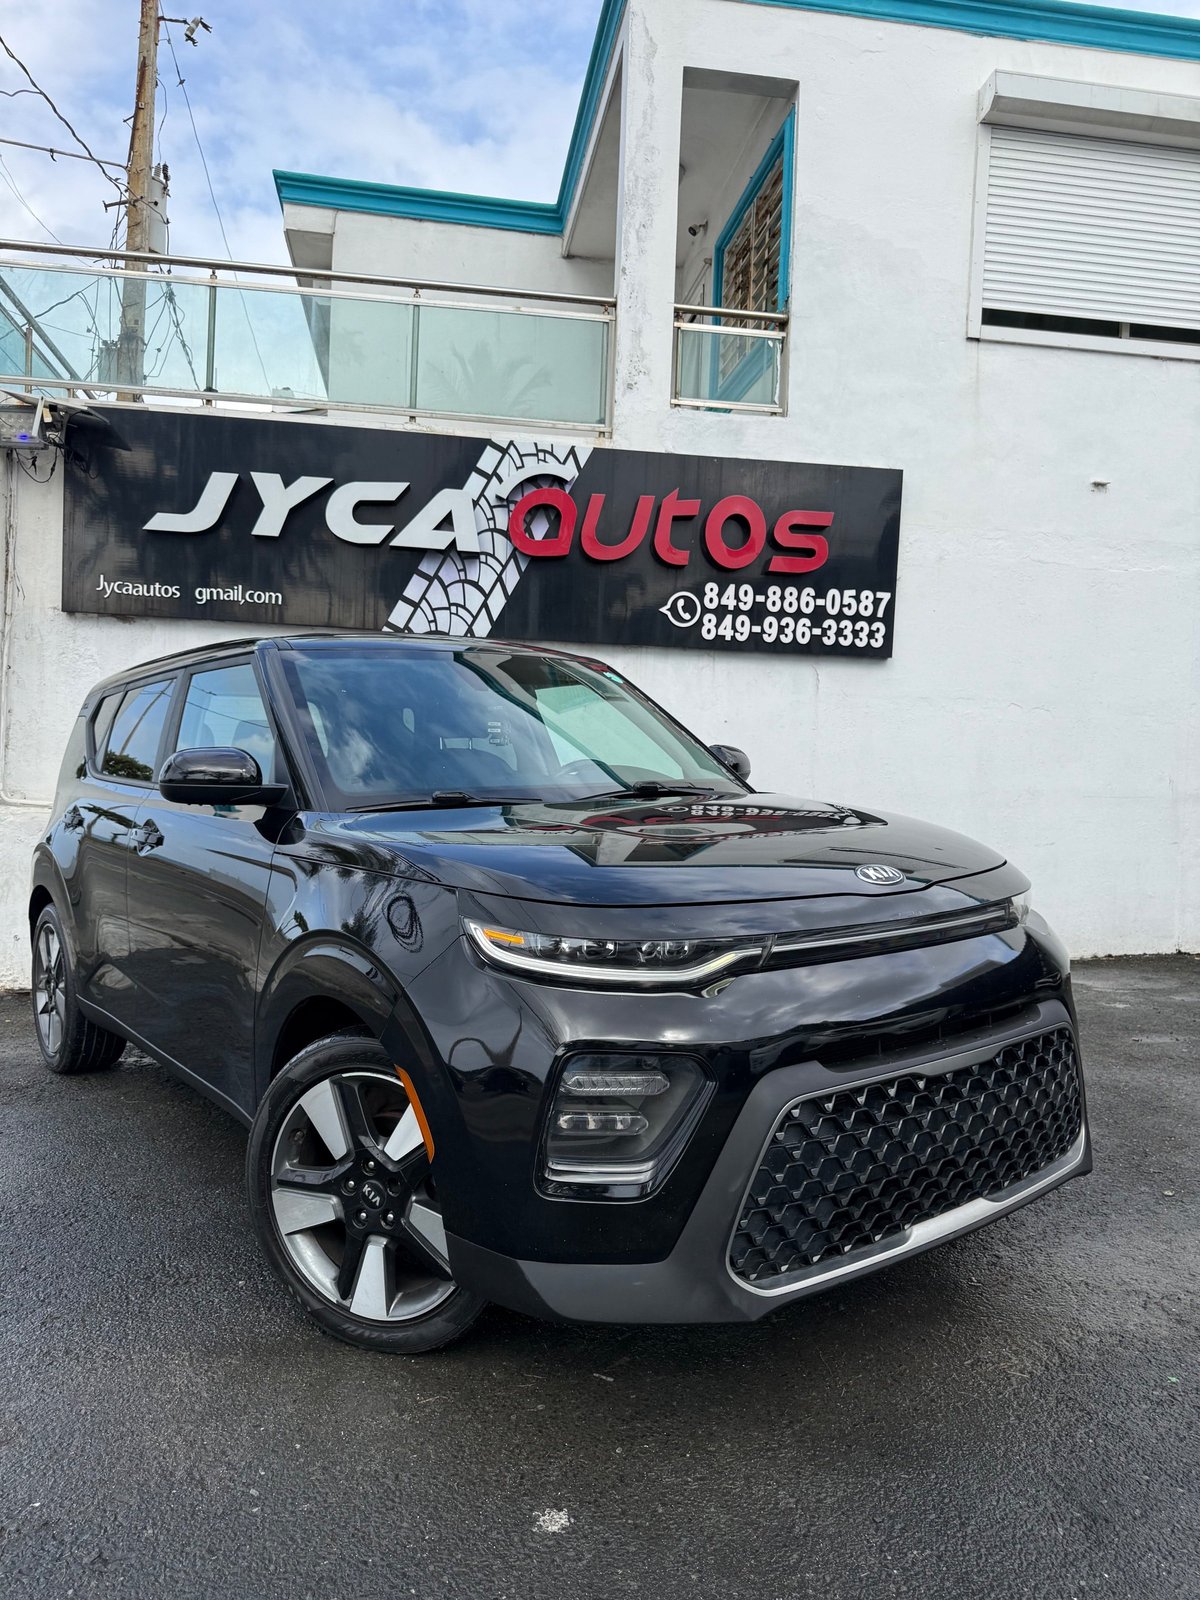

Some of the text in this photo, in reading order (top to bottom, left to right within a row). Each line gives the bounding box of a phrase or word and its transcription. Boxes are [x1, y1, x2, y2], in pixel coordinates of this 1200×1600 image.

[141, 471, 481, 553] JYCA
[95, 574, 181, 598] Jycaautos
[703, 582, 892, 618] 849-886-0587
[701, 613, 887, 649] 849-936-3333
[861, 866, 900, 880] KIA
[362, 1184, 381, 1206] KIA
